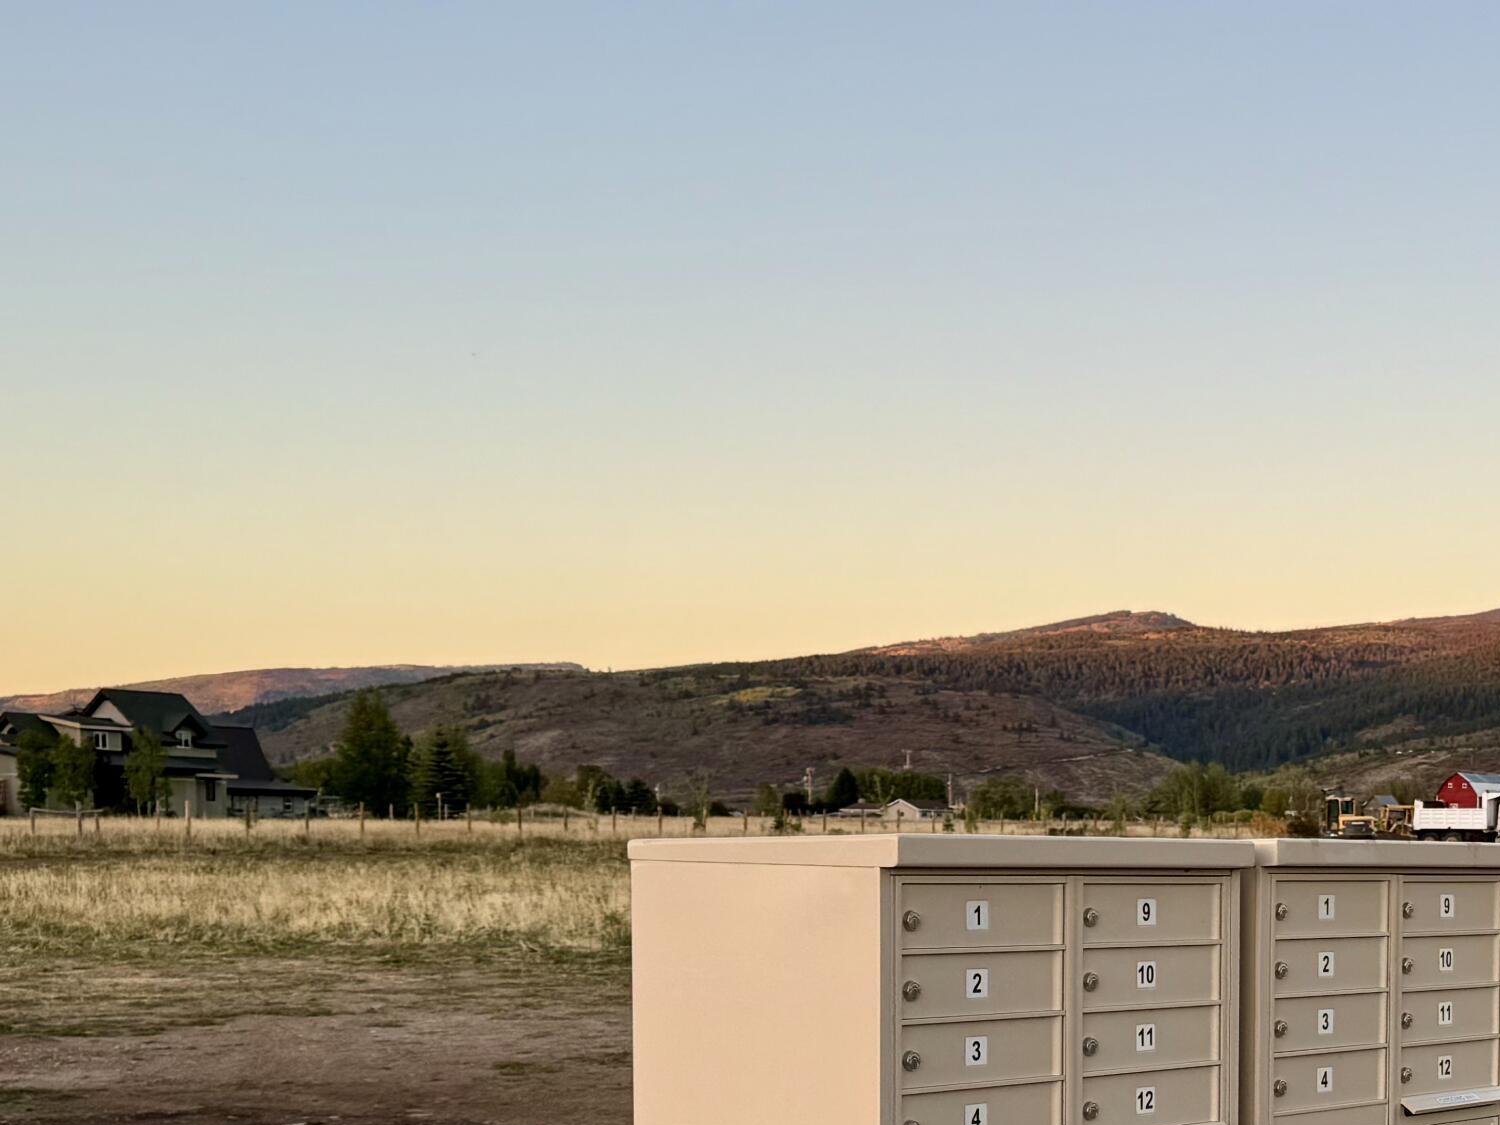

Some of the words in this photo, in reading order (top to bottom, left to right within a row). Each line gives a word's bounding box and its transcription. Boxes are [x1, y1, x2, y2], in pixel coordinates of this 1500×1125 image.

[972, 904, 982, 926] 1
[1142, 902, 1151, 922] 9
[1323, 897, 1331, 916] 1
[1444, 897, 1450, 914] 9
[1322, 955, 1330, 973] 2
[1440, 951, 1452, 968] 10
[972, 972, 982, 994] 2
[1138, 964, 1155, 985] 10
[1322, 1012, 1329, 1031] 3
[1440, 1004, 1451, 1022] 11
[1138, 1027, 1153, 1047] 11
[971, 1040, 981, 1062] 3
[1439, 1059, 1451, 1076] 12
[1320, 1070, 1329, 1088] 4
[1137, 1090, 1154, 1111] 12
